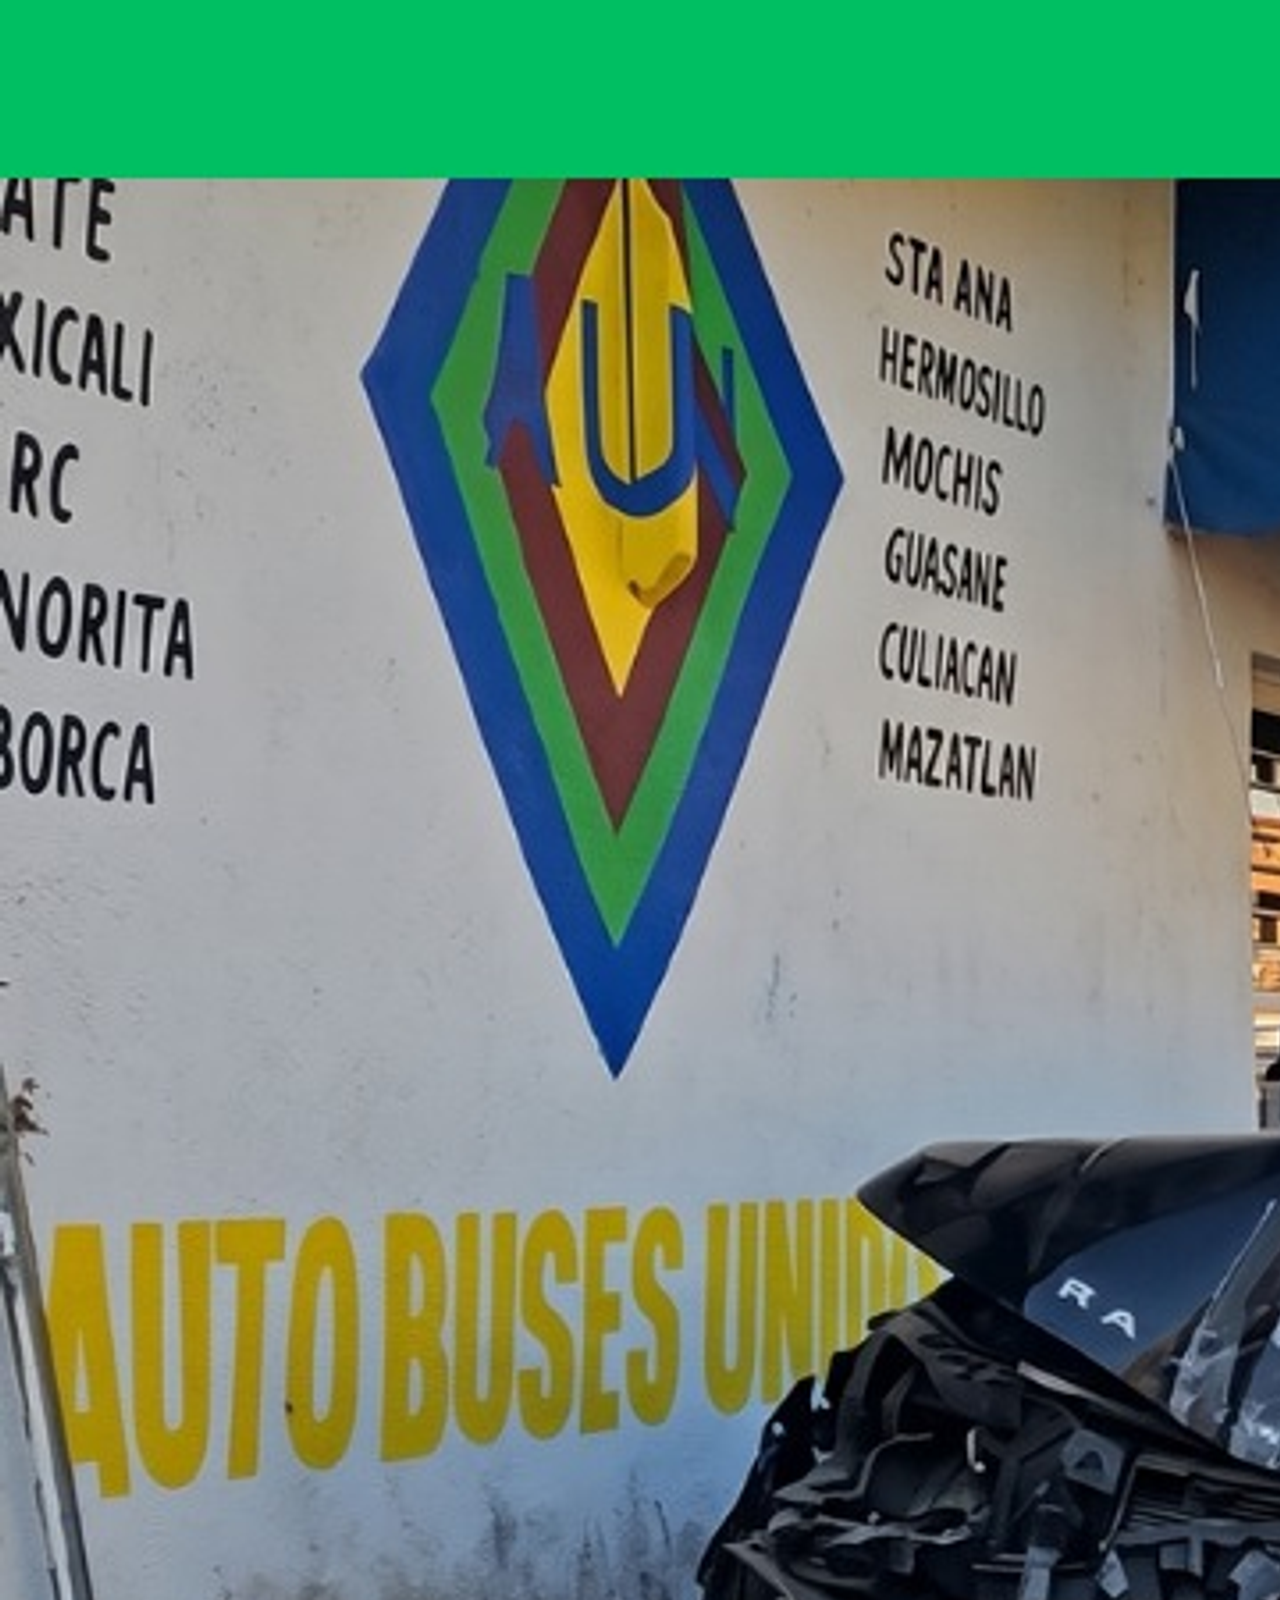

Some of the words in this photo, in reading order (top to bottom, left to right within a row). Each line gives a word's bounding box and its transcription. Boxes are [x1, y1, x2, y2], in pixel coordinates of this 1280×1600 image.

[885, 232, 944, 306] STA
[953, 258, 1012, 333] ANA
[0, 290, 153, 407] XICALI
[879, 325, 1046, 437] HERMOSILLO
[882, 425, 1003, 517] MOCHIS
[884, 526, 1008, 613] GUASANE
[878, 621, 1017, 707] CULIACAN
[878, 717, 1037, 802] MAZATLAN
[44, 1217, 360, 1499] AUTO
[380, 1206, 685, 1464] BUSES
